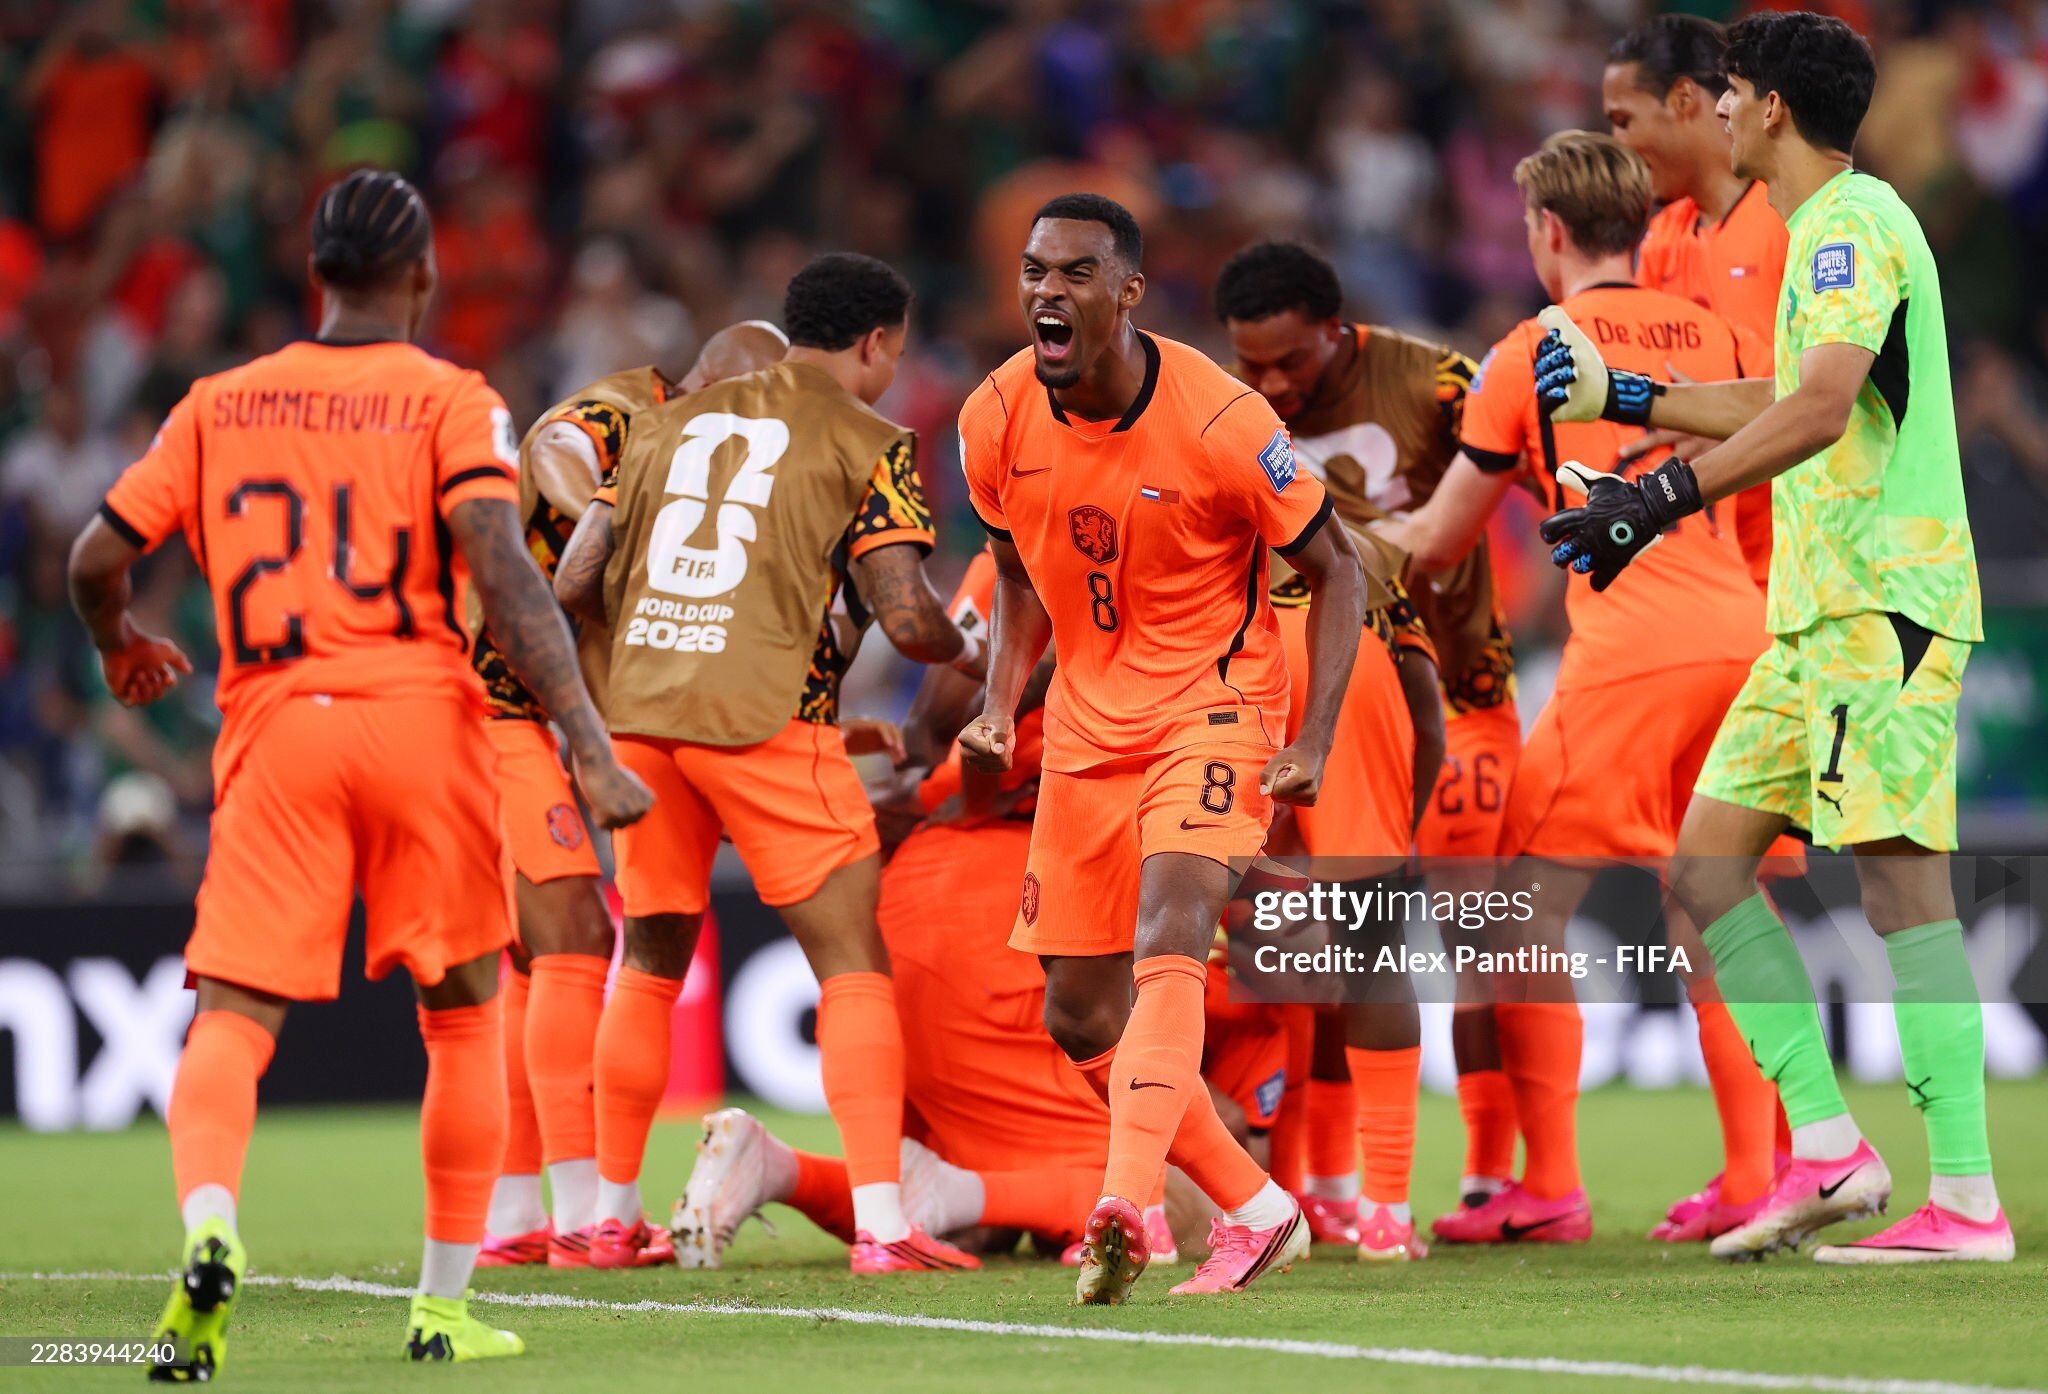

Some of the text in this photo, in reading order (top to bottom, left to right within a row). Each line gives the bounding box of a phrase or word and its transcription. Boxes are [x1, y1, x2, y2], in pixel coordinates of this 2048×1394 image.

[1637, 321, 1702, 350] JONG
[214, 389, 436, 434] SUMMERVILLE
[1658, 473, 1677, 502] BONO
[224, 478, 414, 667] 24
[672, 556, 715, 578] FIFA
[698, 604, 735, 623] CUP
[1087, 571, 1120, 633] 8
[625, 617, 728, 653] 2026
[1820, 704, 1848, 782] 1
[1199, 761, 1236, 815] 8
[1438, 754, 1501, 815] 26
